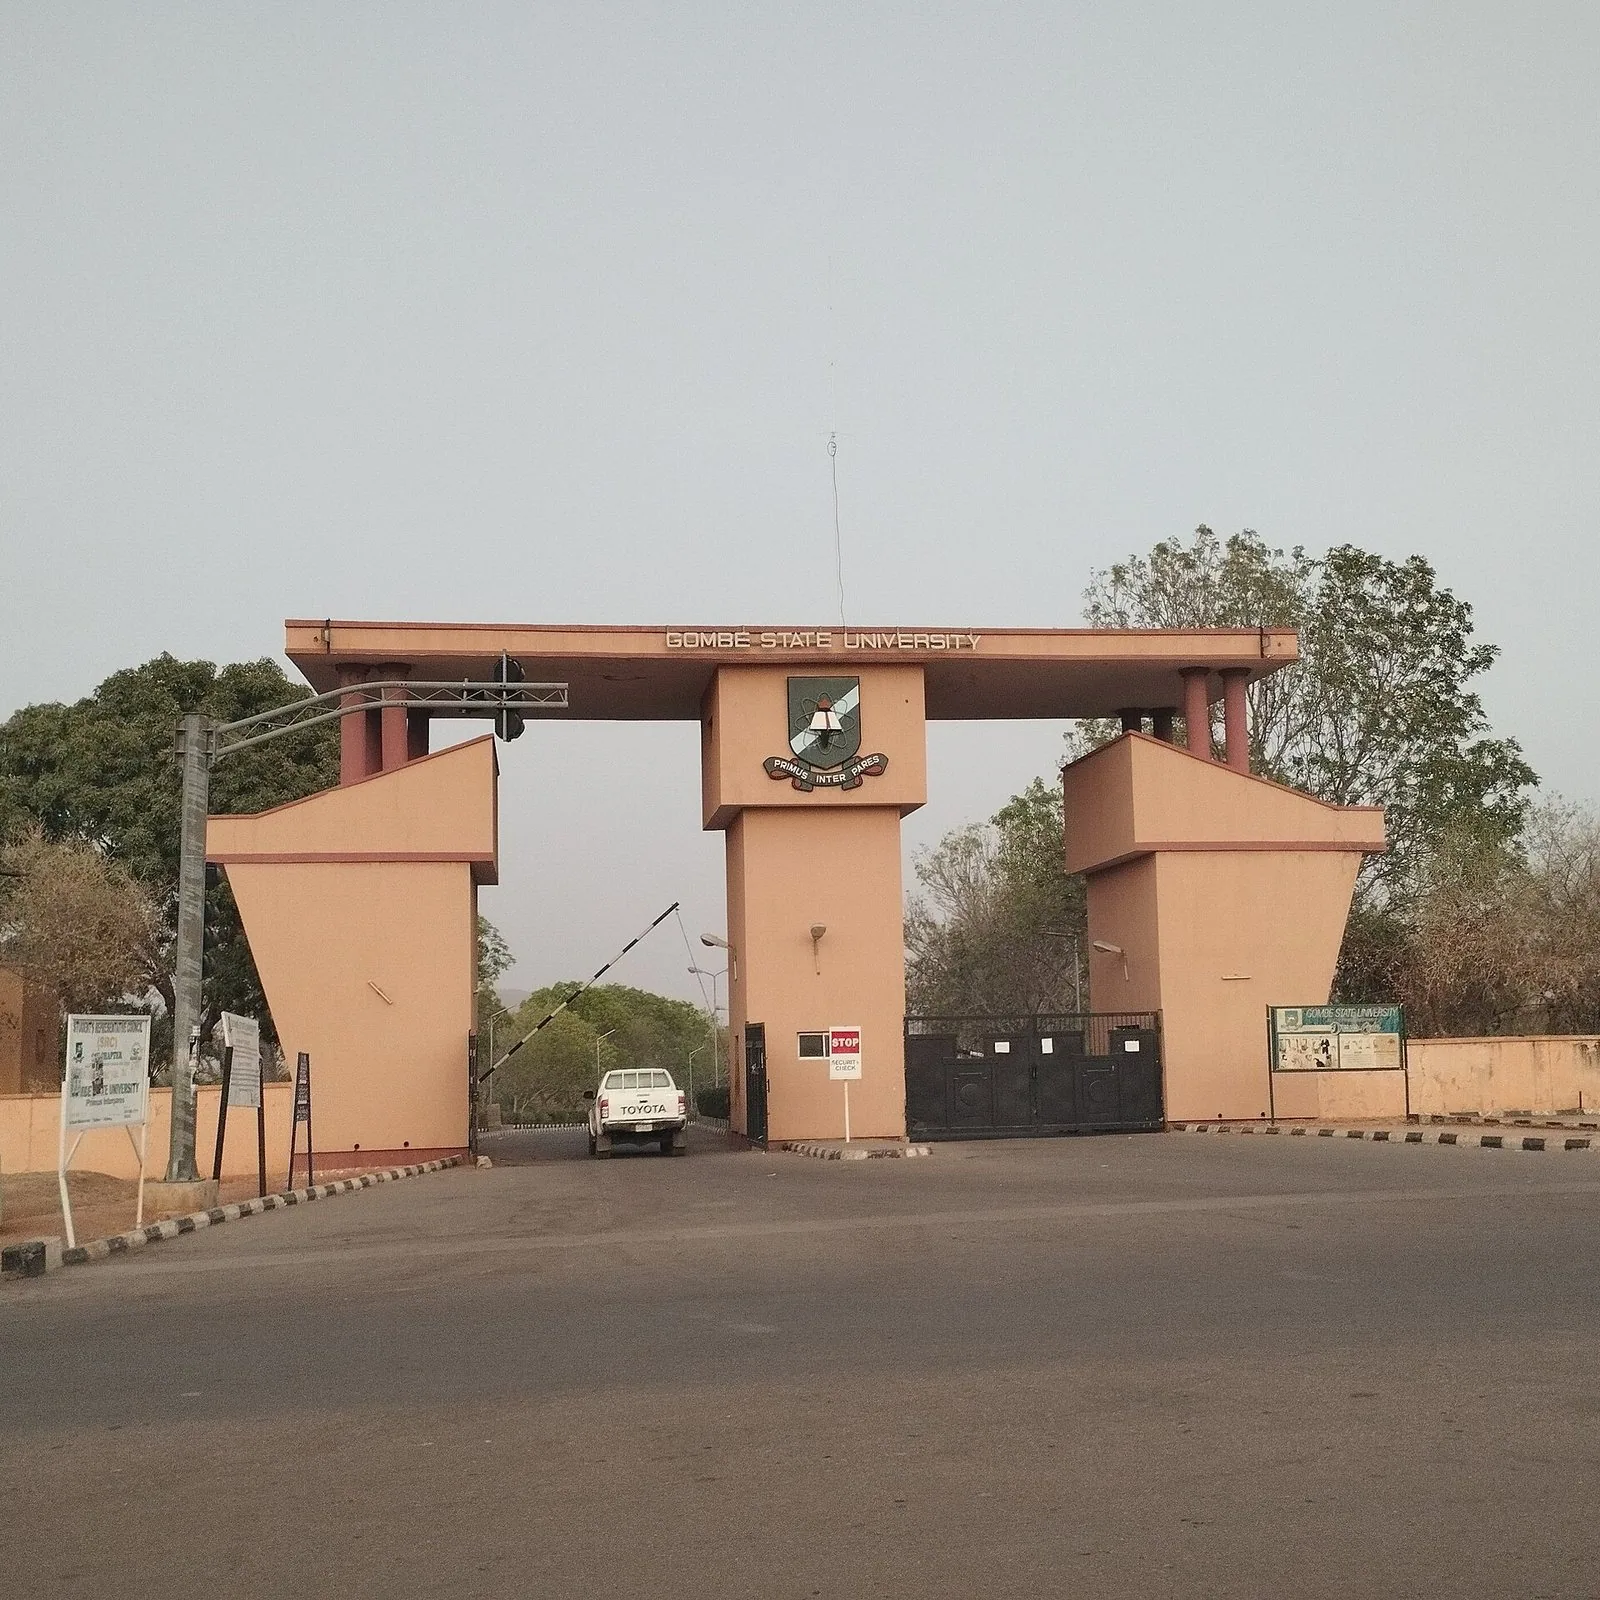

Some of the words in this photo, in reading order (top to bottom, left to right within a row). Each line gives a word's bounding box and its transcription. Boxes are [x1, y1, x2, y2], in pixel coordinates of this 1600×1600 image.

[666, 632, 750, 649] GOMBE
[760, 632, 832, 648] STATE
[844, 633, 982, 650] UNIVERSITY
[774, 760, 809, 780] PRIMUS
[816, 774, 846, 783] INTER
[851, 755, 880, 776] PARES
[832, 1037, 859, 1048] STOP
[621, 1104, 667, 1115] TOYOTA
